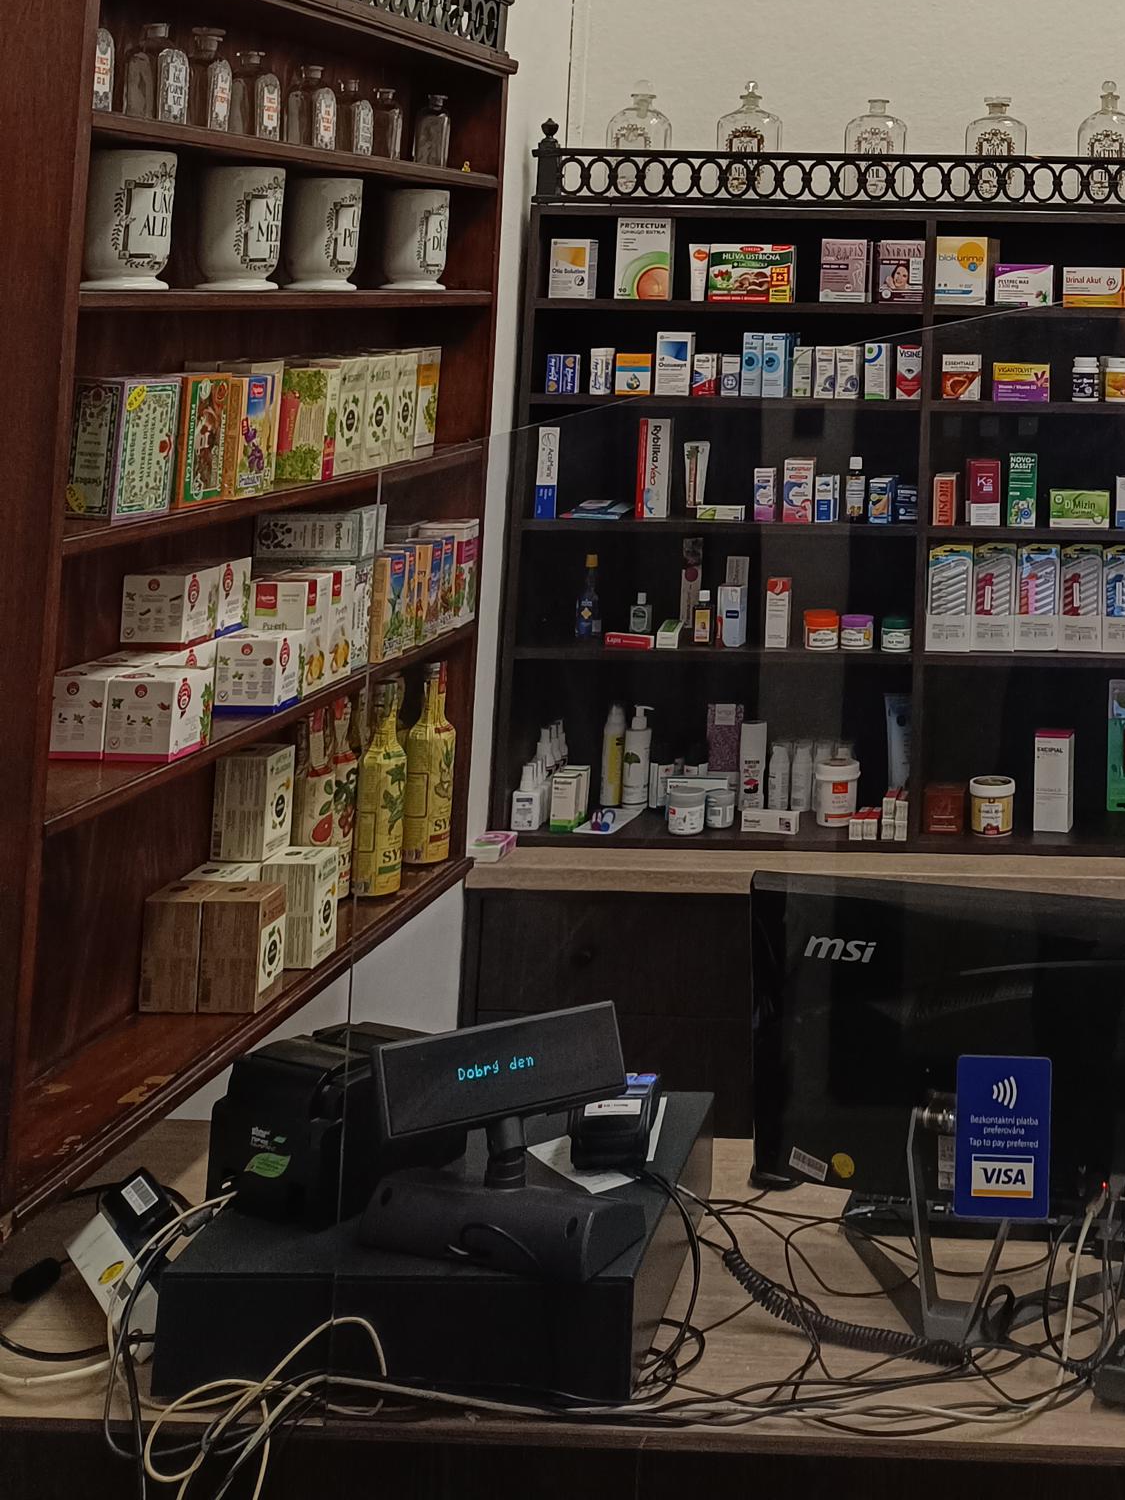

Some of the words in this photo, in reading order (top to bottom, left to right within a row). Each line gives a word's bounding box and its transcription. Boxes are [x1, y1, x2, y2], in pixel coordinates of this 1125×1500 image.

[619, 222, 667, 230] PROTECTUM
[771, 273, 788, 283] 1+1
[1065, 275, 1085, 284] Urinal
[899, 349, 922, 359] VISINE
[651, 424, 662, 463] Rybilka
[977, 476, 993, 487] K2
[804, 936, 877, 964] msi
[509, 1055, 535, 1070] den
[970, 1114, 1015, 1124] Bezkontaktní
[1016, 1117, 1039, 1126] platba
[983, 1125, 1025, 1135] preferována
[969, 1137, 981, 1147] Tap
[983, 1138, 991, 1147] to
[992, 1139, 1005, 1148] pay
[1006, 1139, 1039, 1148] preferred
[980, 1167, 1026, 1185] VISA
